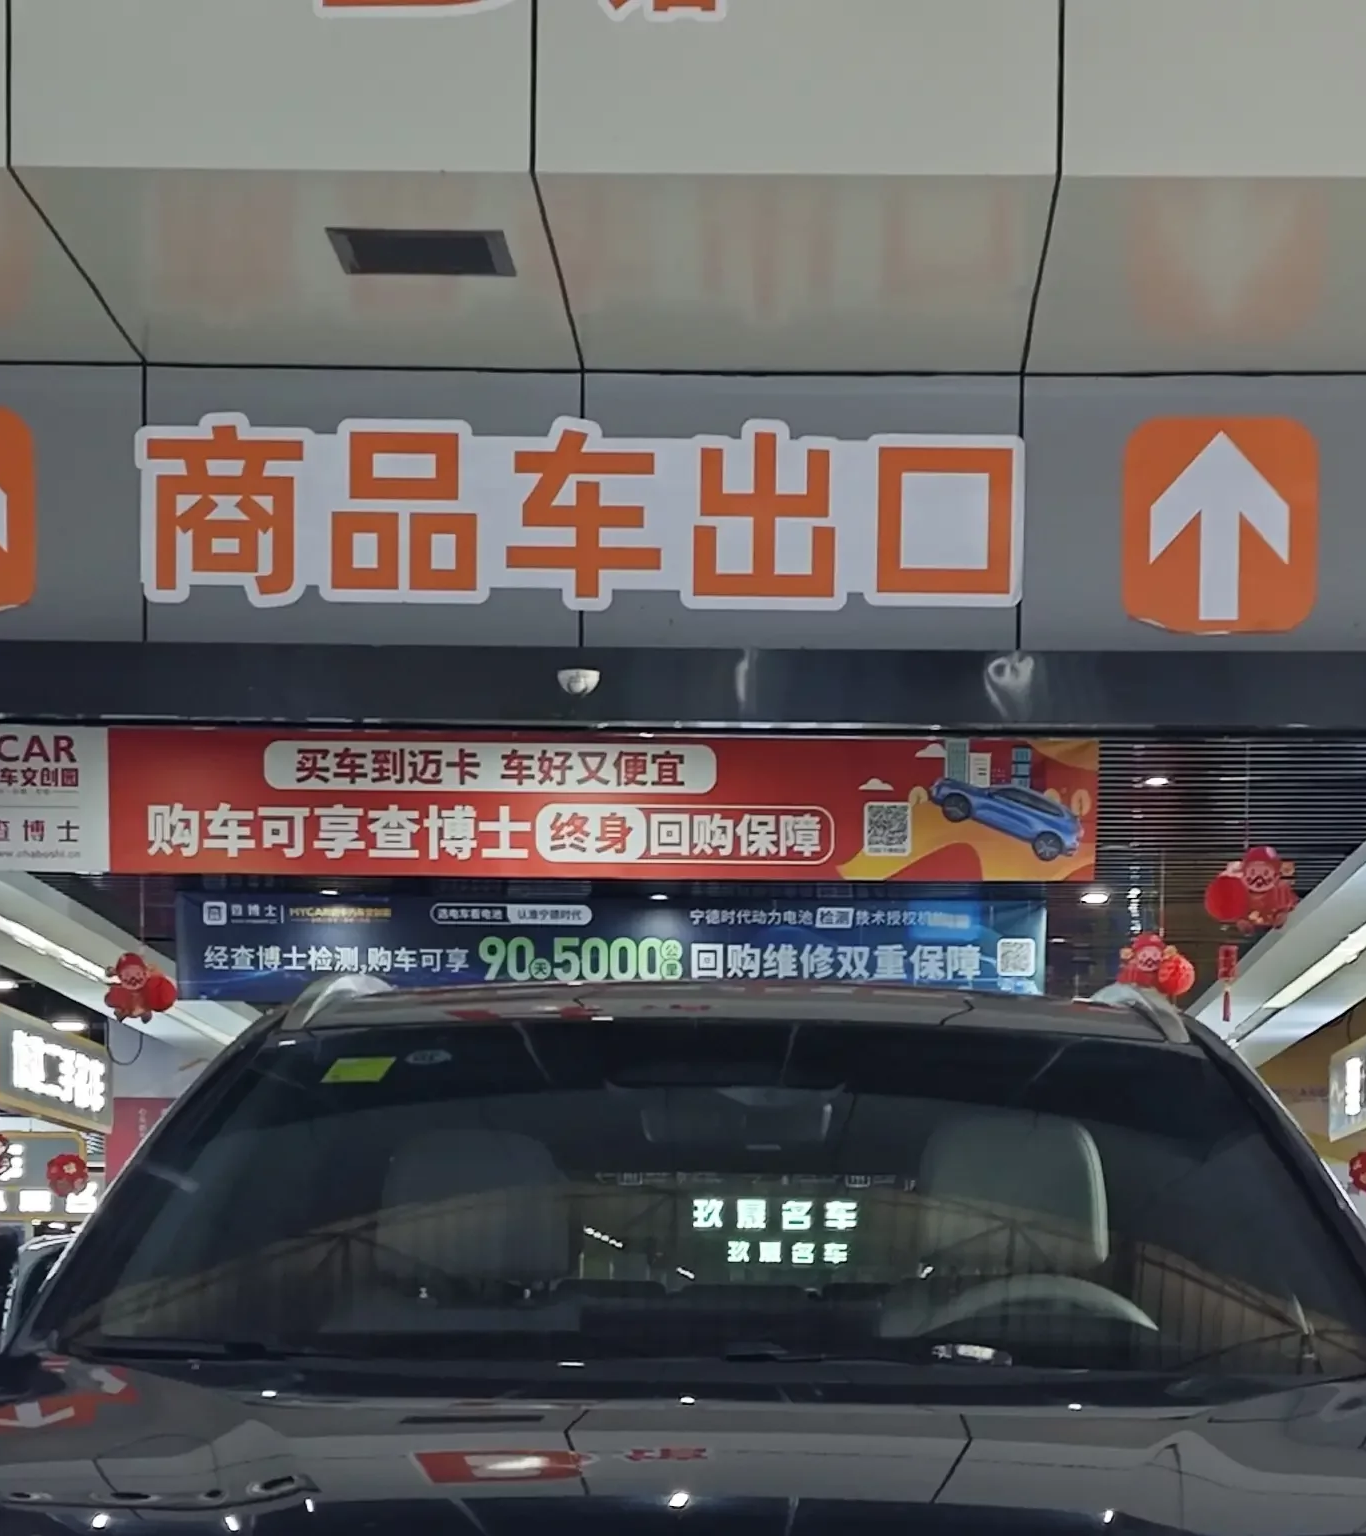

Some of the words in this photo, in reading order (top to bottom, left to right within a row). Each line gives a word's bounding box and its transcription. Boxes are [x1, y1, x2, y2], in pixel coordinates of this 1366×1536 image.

[144, 425, 1014, 598] 商品车出口
[295, 747, 481, 784] 买车到迈卡
[500, 749, 685, 787] 车好又便宜
[147, 803, 821, 861] 购车可享查博士终身回购保障
[690, 943, 982, 981] 回购维修双重保障
